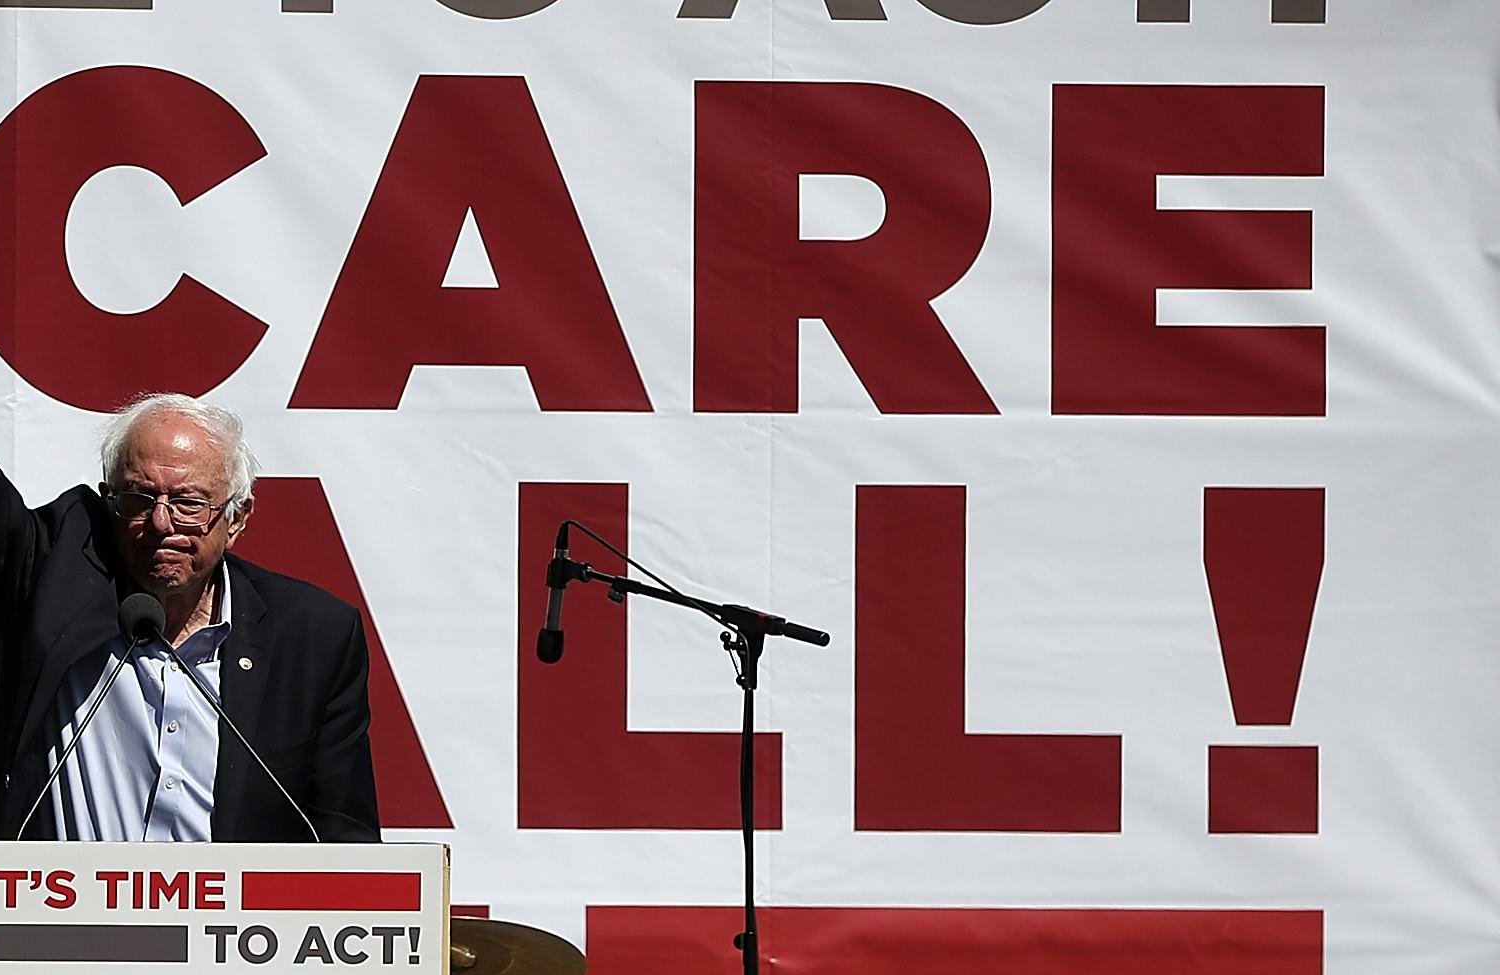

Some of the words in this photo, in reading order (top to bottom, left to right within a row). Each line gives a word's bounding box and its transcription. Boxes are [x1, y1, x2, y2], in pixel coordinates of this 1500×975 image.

[96, 871, 226, 909] TIME
[205, 925, 278, 964] TO
[295, 925, 421, 965] ACT!
